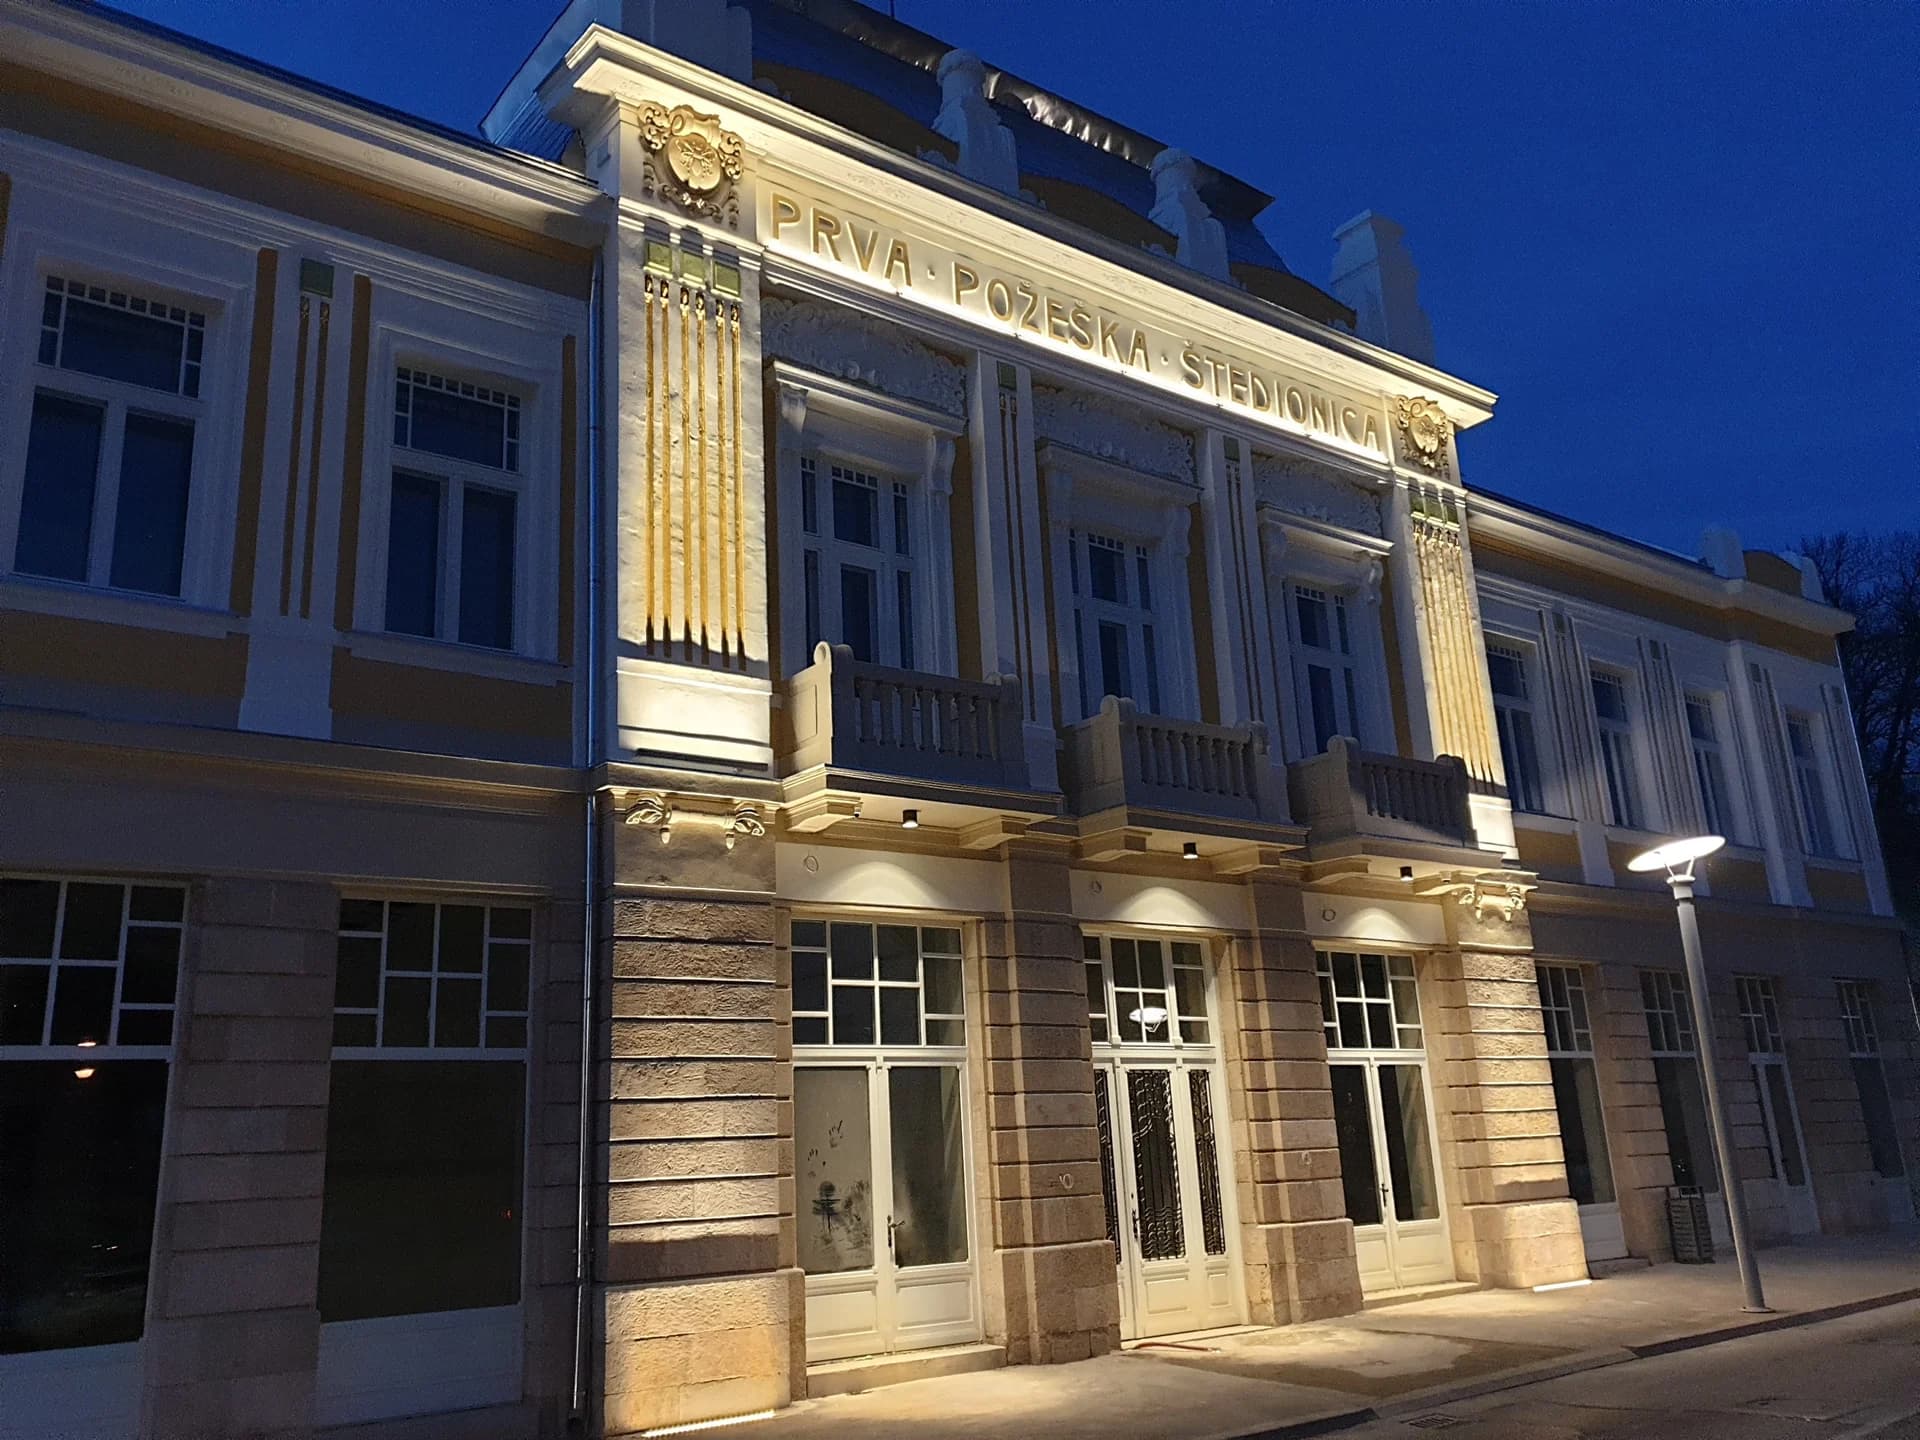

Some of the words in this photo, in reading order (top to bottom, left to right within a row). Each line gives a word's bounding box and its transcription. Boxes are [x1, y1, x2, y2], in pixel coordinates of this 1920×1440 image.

[770, 192, 912, 288] PRVA
[951, 261, 1151, 373] POŽEŠKA
[1179, 339, 1380, 453] ŠTEDIONICA
